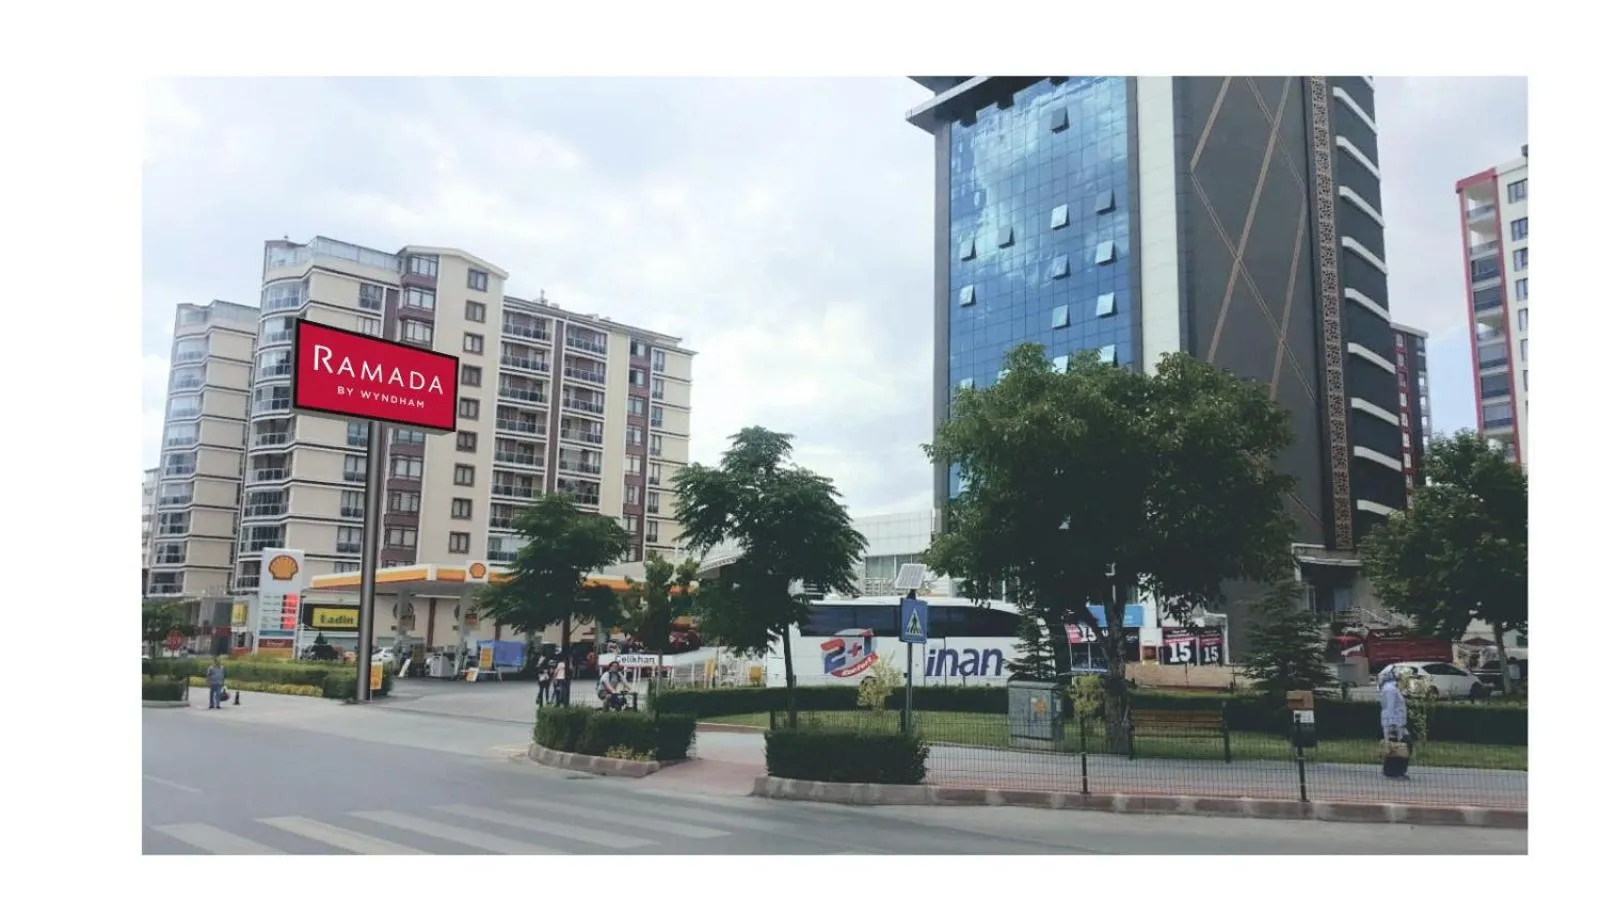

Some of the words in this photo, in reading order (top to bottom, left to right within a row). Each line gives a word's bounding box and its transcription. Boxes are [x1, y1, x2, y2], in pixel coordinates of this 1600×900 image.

[313, 344, 444, 395] RAMADA
[337, 386, 354, 396] BY
[360, 390, 425, 408] WYNDHAM
[1169, 641, 1192, 662] 15
[1204, 646, 1219, 662] 15
